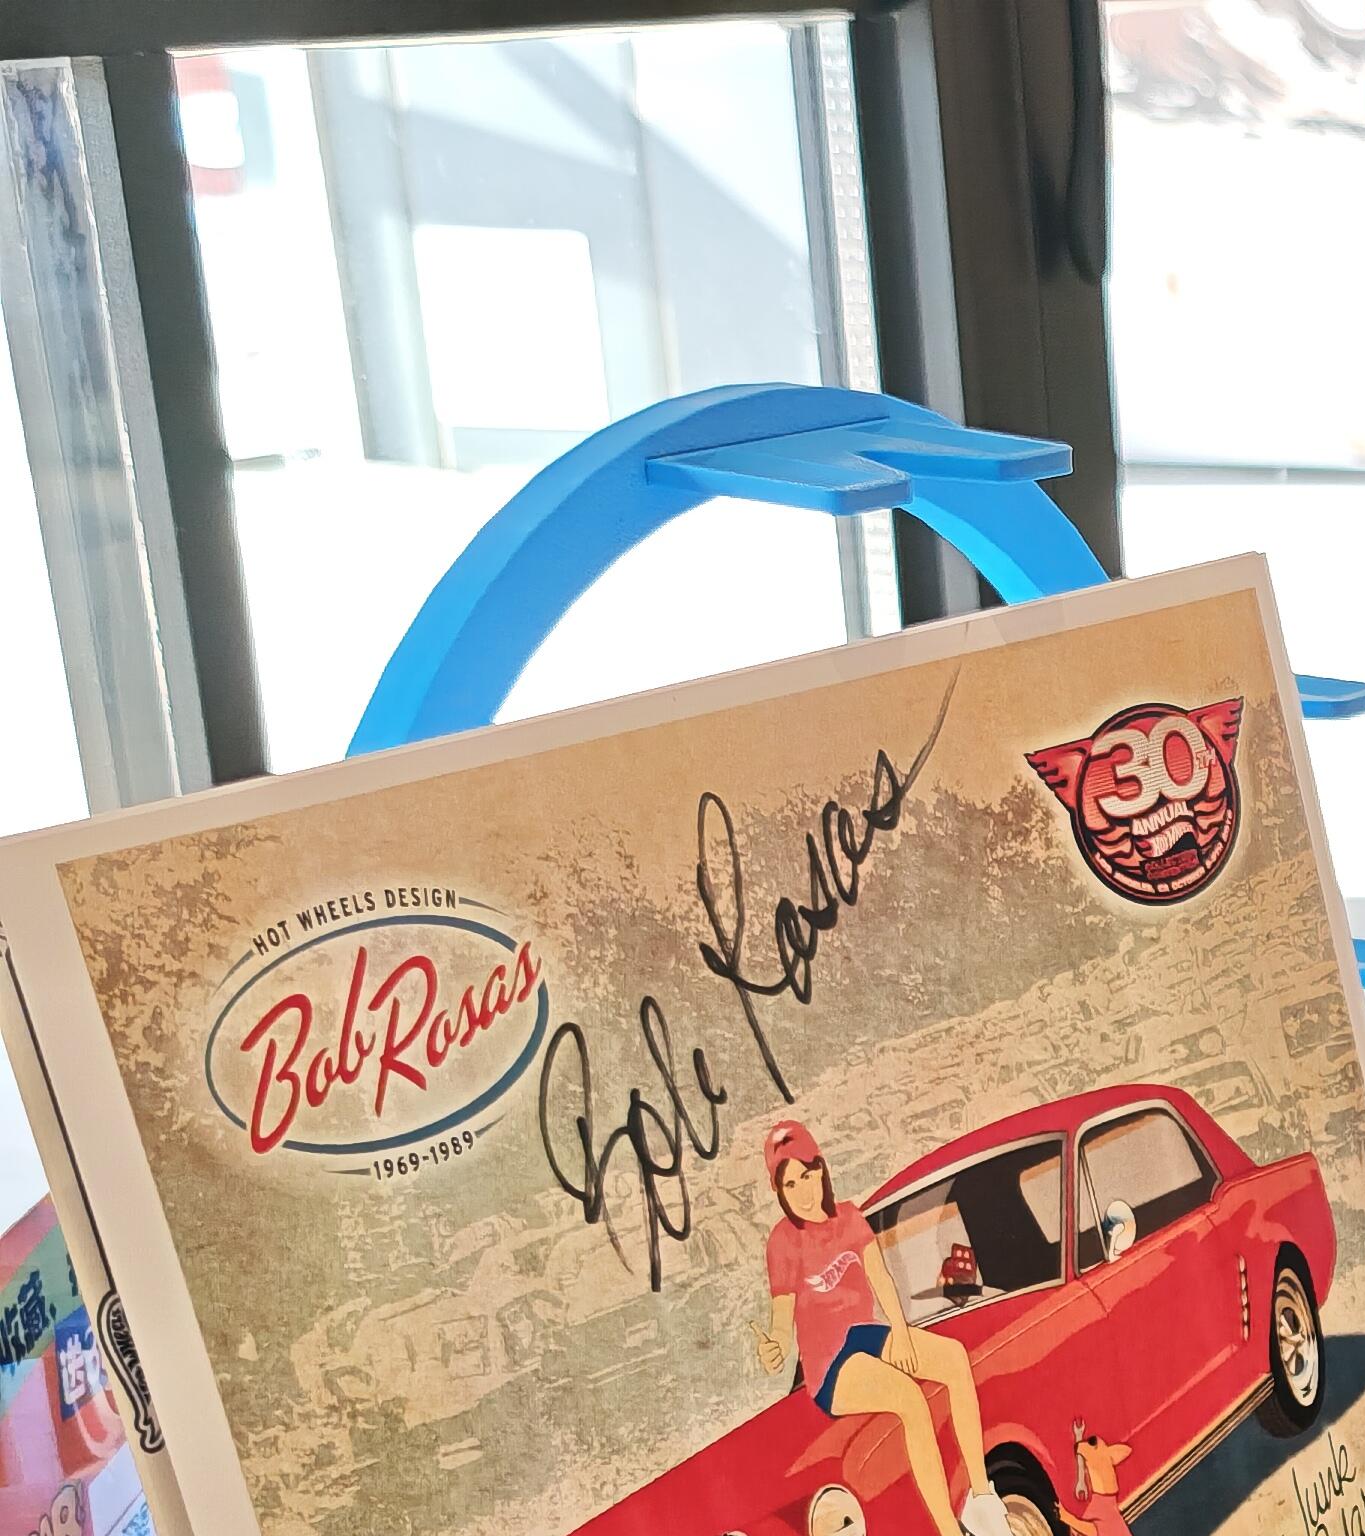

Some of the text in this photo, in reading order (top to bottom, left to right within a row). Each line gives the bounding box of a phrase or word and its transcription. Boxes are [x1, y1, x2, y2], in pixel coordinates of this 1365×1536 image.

[1132, 800, 1194, 836] ANNUAL
[253, 887, 457, 956] HOT WHEELS DESIGN
[240, 940, 542, 1155] Bob Rosas
[372, 1130, 475, 1181] 1969-1989
